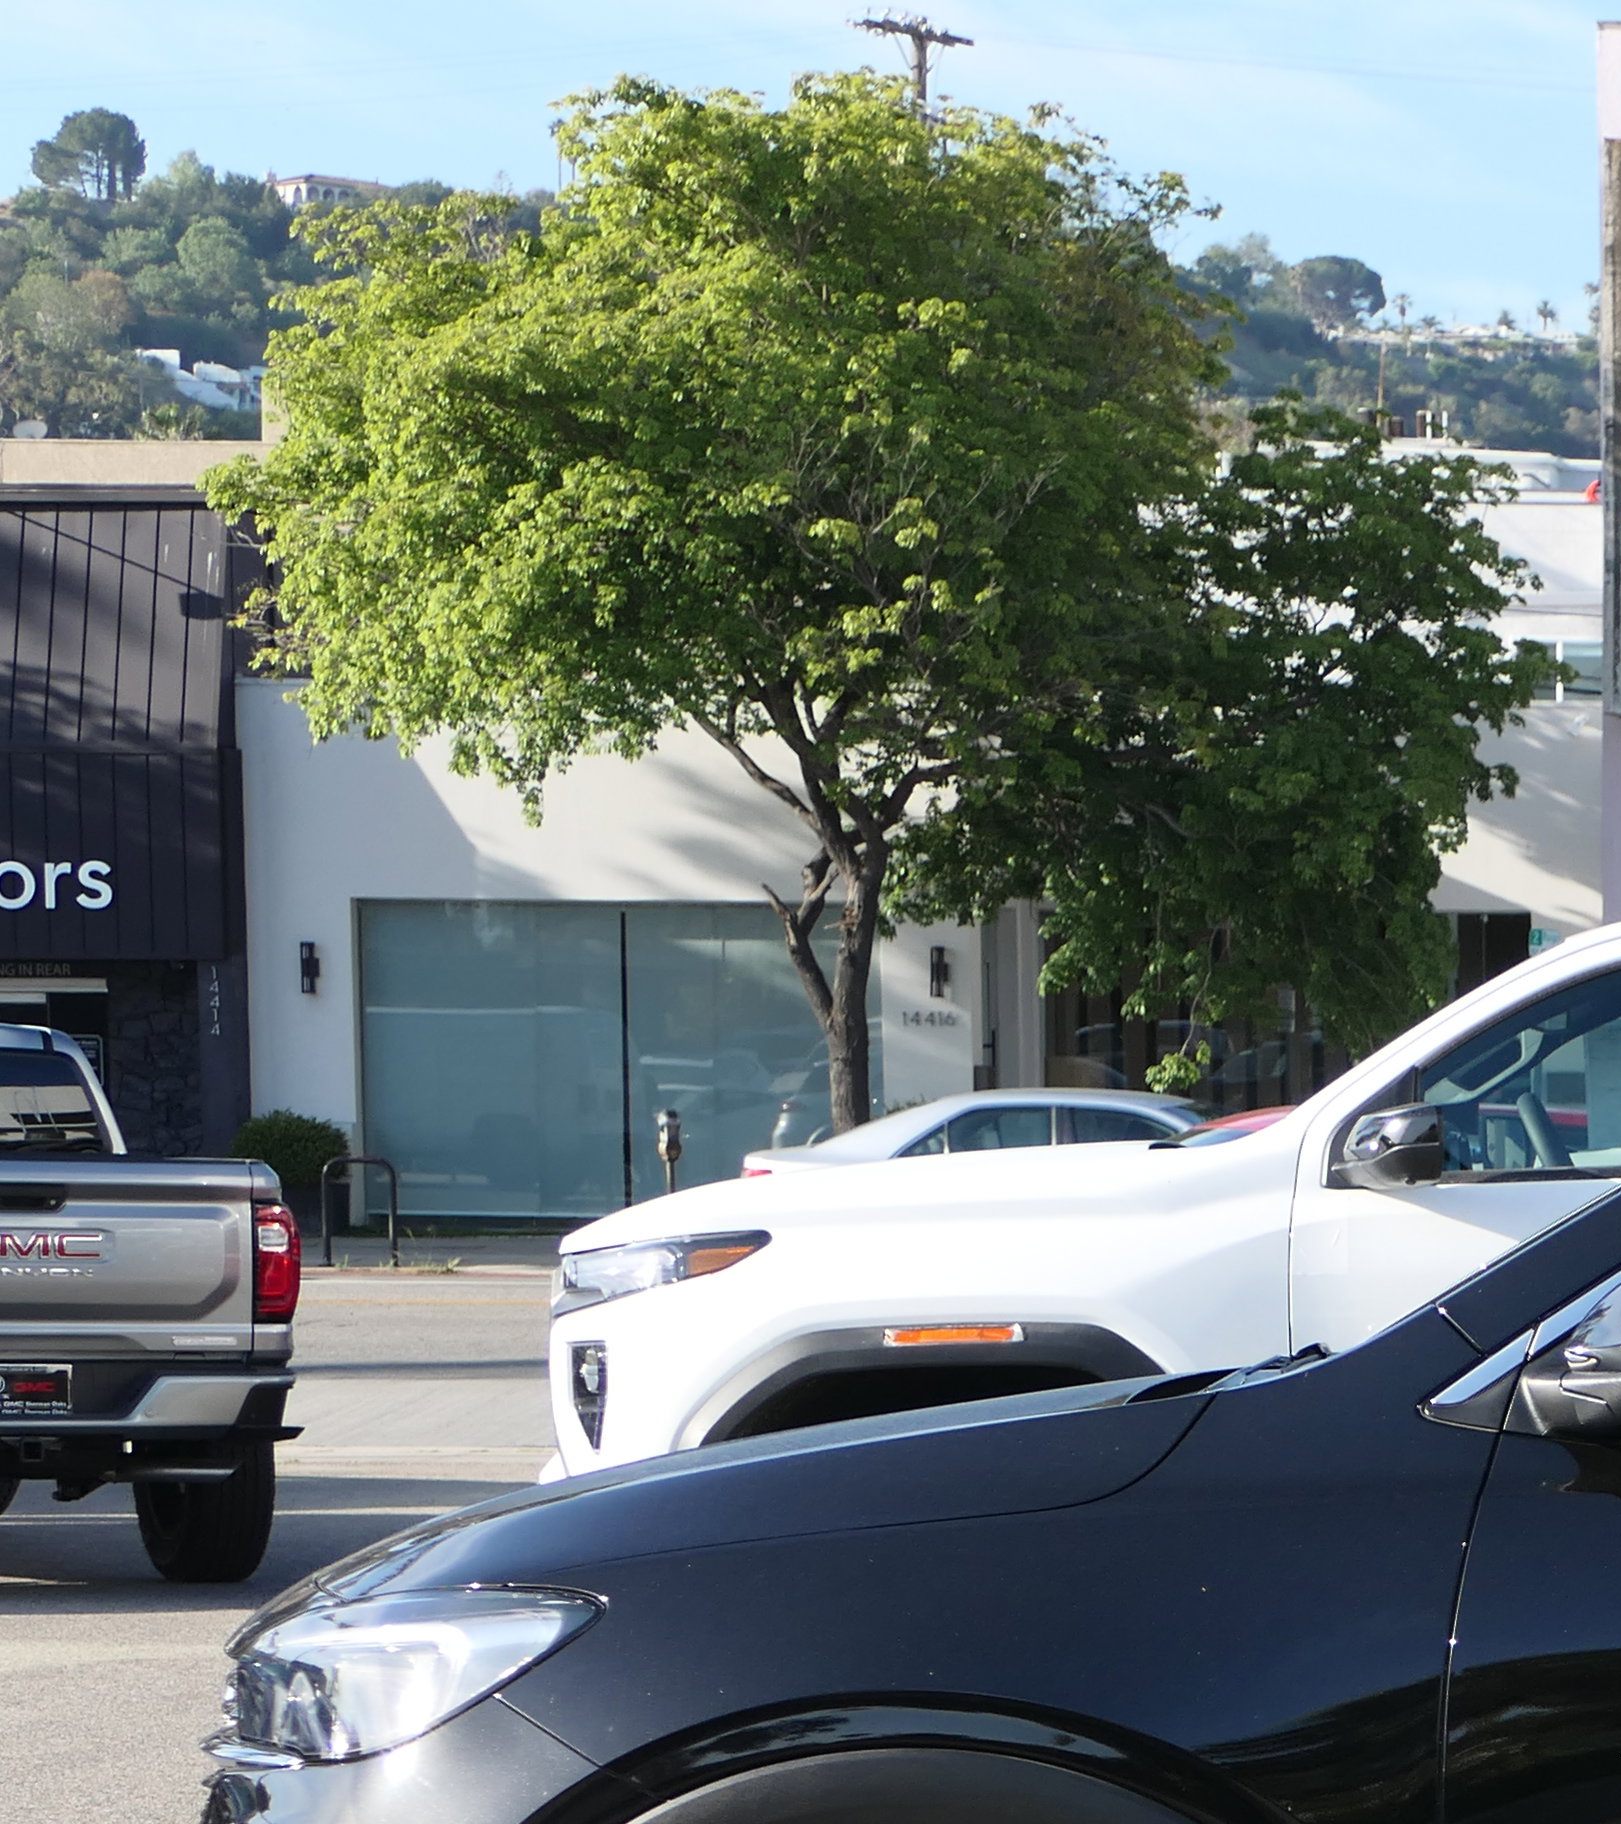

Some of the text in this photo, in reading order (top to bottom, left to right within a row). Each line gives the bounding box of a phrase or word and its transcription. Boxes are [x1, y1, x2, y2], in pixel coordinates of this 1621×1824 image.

[0, 860, 113, 910] ors
[18, 963, 33, 976] IN
[36, 963, 71, 976] REAR
[208, 966, 220, 1036] 14414
[902, 1010, 957, 1027] 14416
